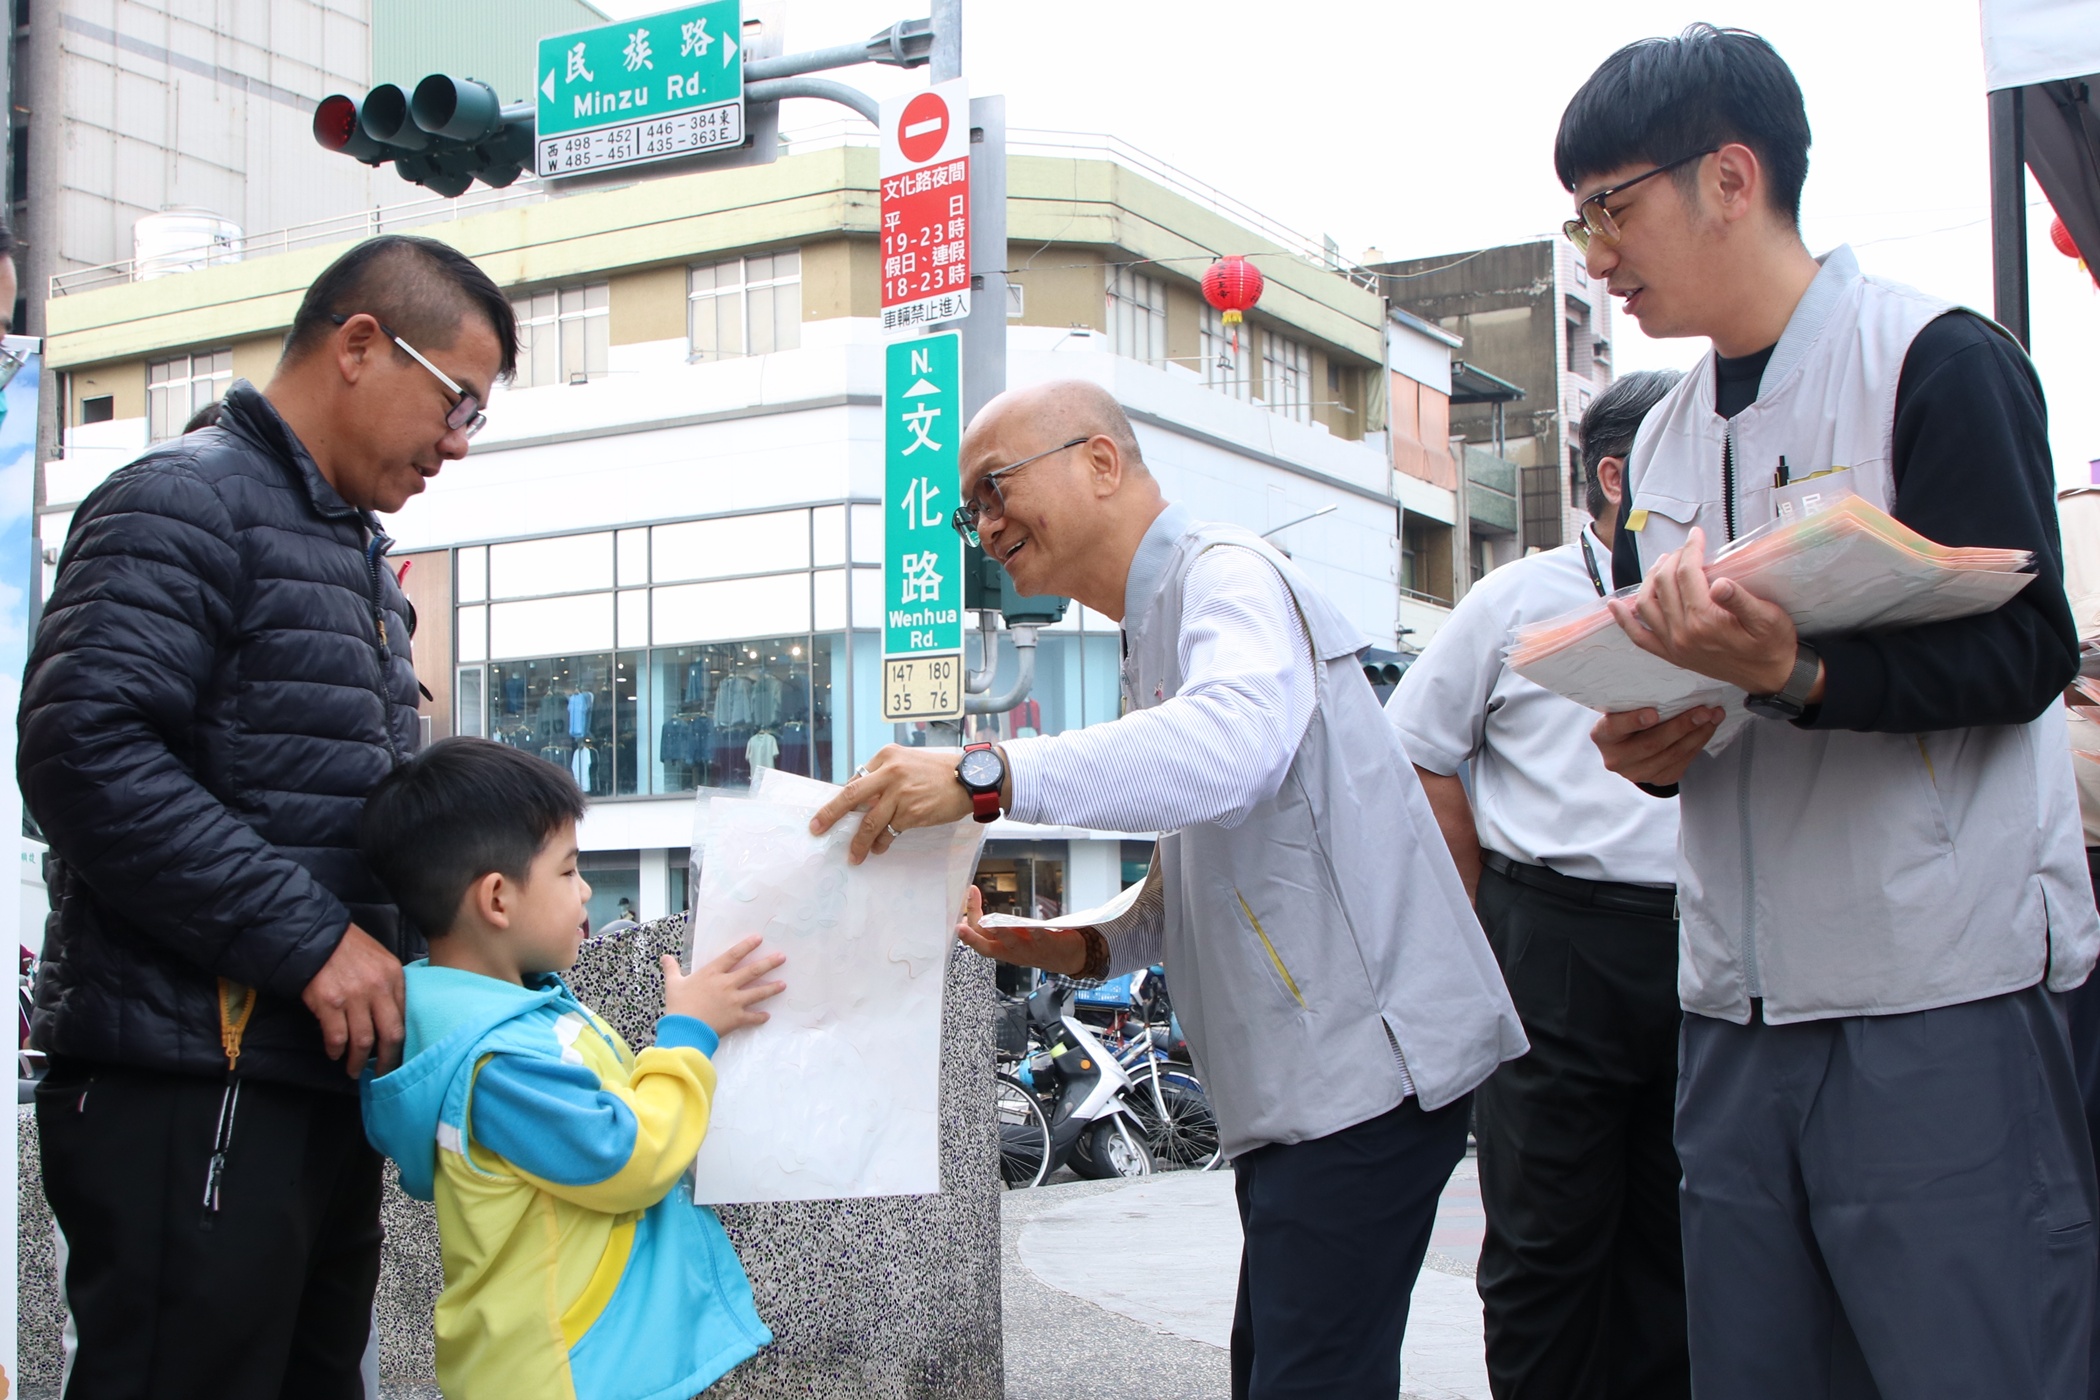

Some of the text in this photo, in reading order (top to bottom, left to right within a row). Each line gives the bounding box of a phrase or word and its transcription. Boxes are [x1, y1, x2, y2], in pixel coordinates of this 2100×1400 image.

[565, 17, 716, 84] 民族路
[573, 71, 707, 119] Minzu Rd.
[720, 109, 731, 126] 東
[547, 143, 559, 158] 西
[883, 160, 966, 202] 文化路夜間
[883, 294, 967, 329] 車輛禁止進入
[901, 401, 944, 606] 文化路
[888, 607, 958, 629] Wenhua
[910, 629, 938, 649] Rd.
[892, 661, 951, 683] 147 180
[893, 690, 948, 712] 35 76
